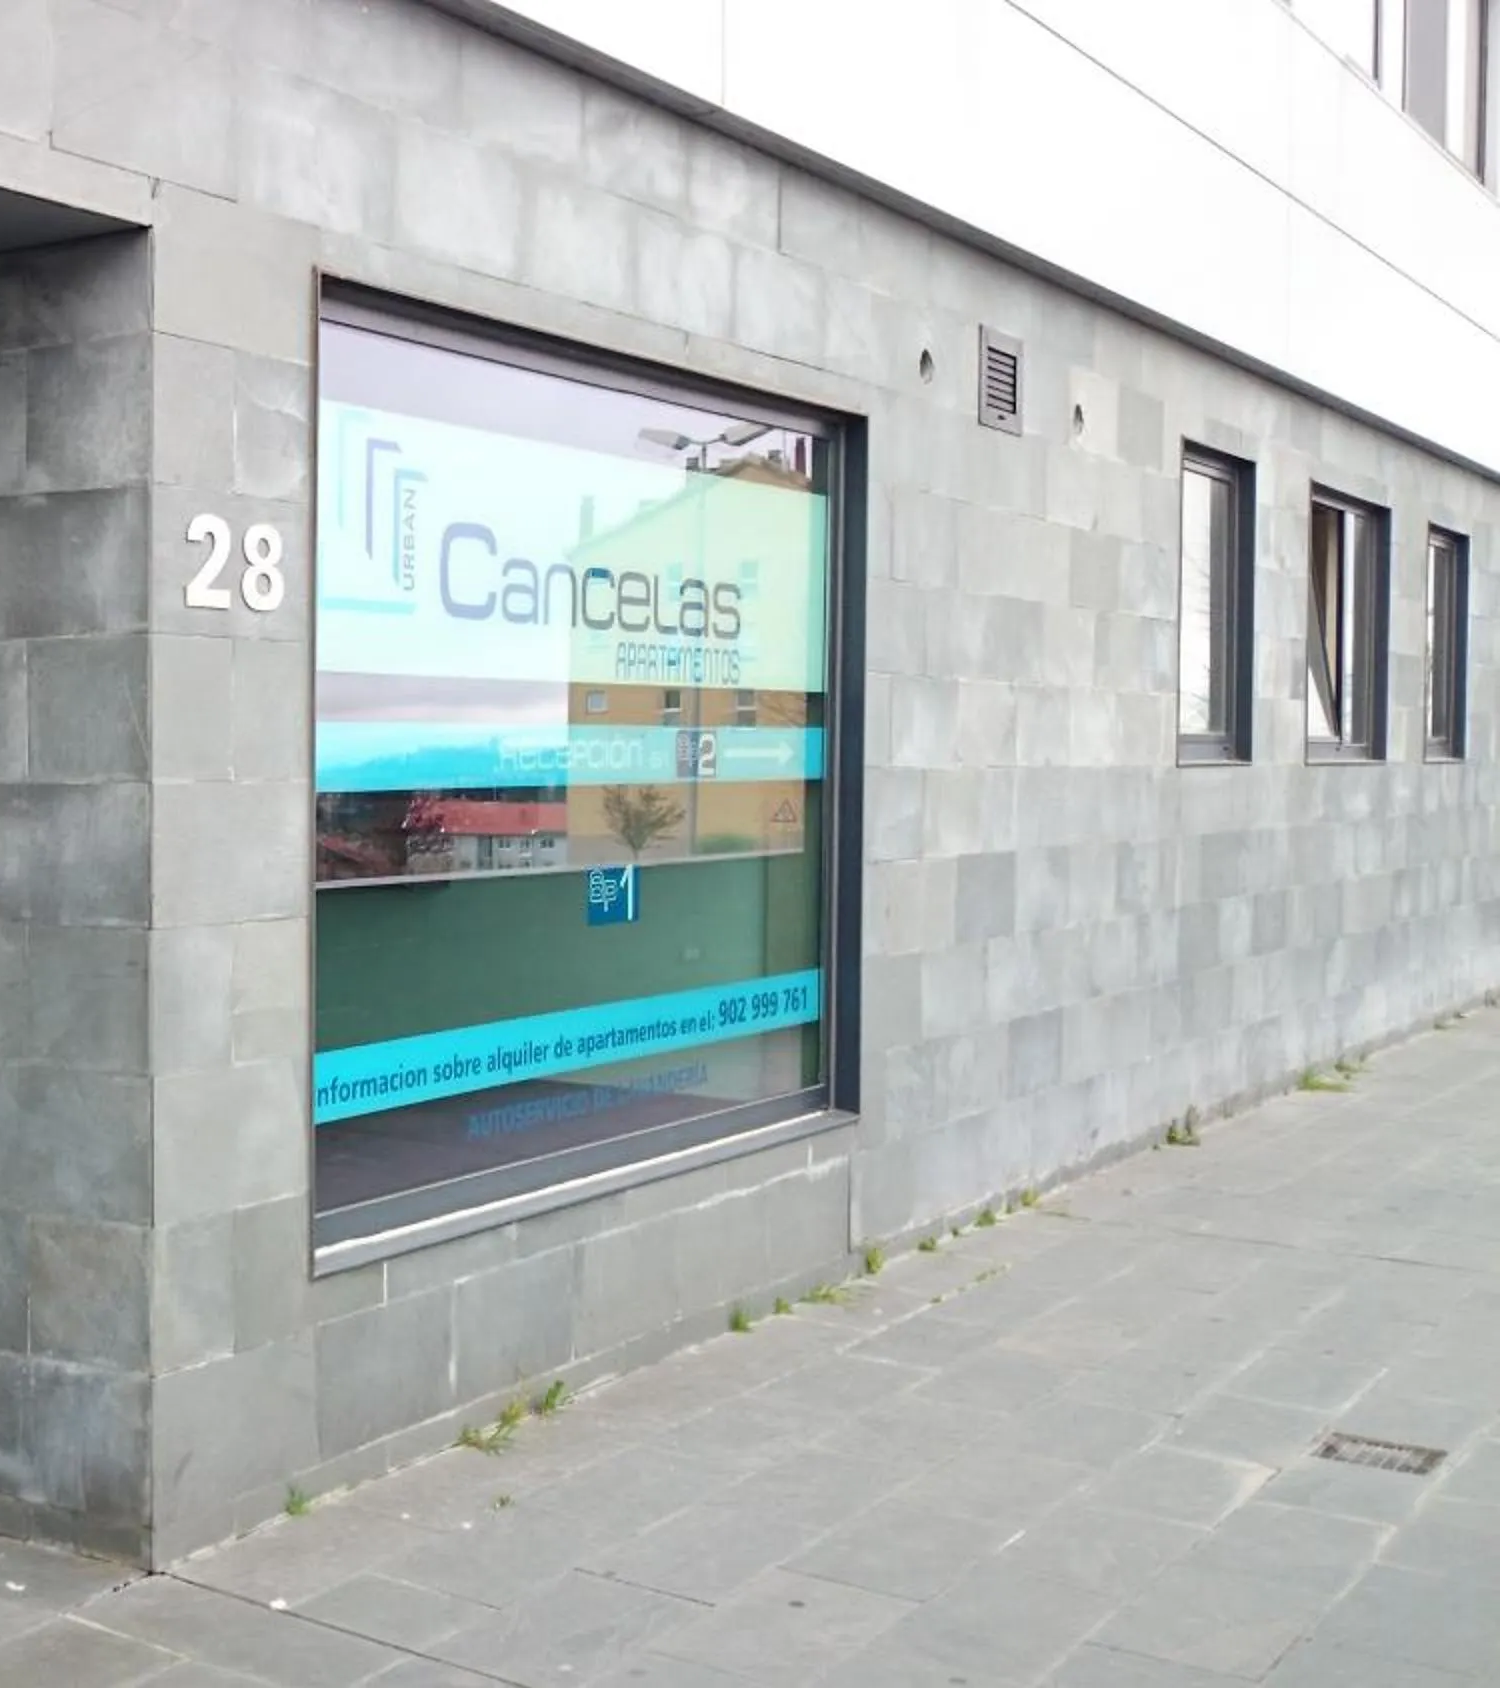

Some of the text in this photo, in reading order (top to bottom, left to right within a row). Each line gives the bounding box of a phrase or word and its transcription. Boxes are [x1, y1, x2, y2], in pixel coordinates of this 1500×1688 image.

[183, 513, 285, 612] 28
[403, 488, 417, 591] URBAN
[439, 521, 742, 640] Cancelas
[615, 641, 741, 686] APARTAMENTOS
[315, 1064, 427, 1107] nformacion
[433, 1054, 481, 1084] sobre
[487, 1040, 549, 1074] alquiler
[554, 1034, 573, 1058] de
[577, 1018, 677, 1058] apartamentos
[680, 1018, 697, 1036] en
[718, 997, 747, 1027] 902
[751, 991, 779, 1020] 999
[782, 985, 808, 1014] 761
